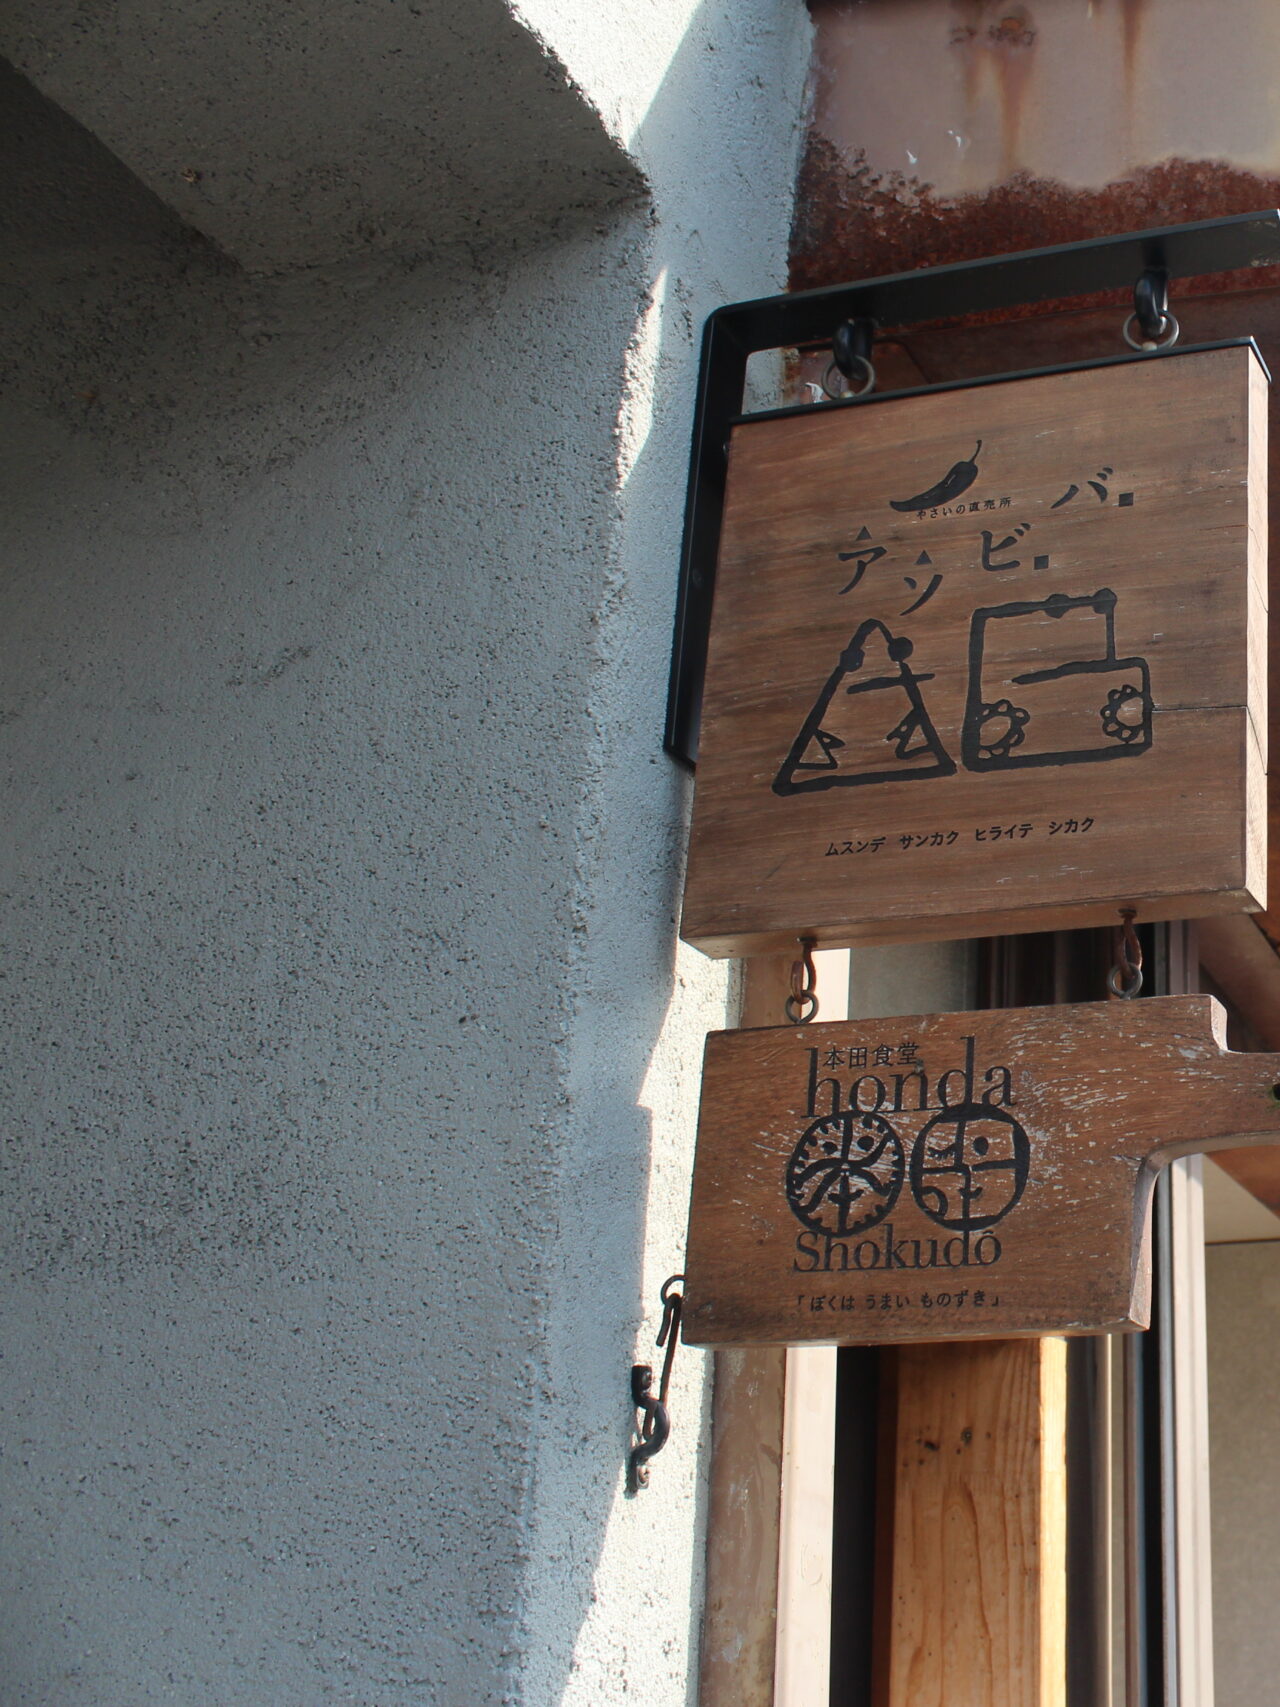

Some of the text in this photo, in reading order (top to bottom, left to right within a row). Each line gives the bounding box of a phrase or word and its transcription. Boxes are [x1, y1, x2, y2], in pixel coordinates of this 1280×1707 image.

[916, 496, 1012, 520] やさいの直売所
[825, 817, 1095, 857] ムスンデ サンカク ヒライテ シカク
[823, 1042, 920, 1070] 本田食堂
[802, 1036, 1017, 1118] honda
